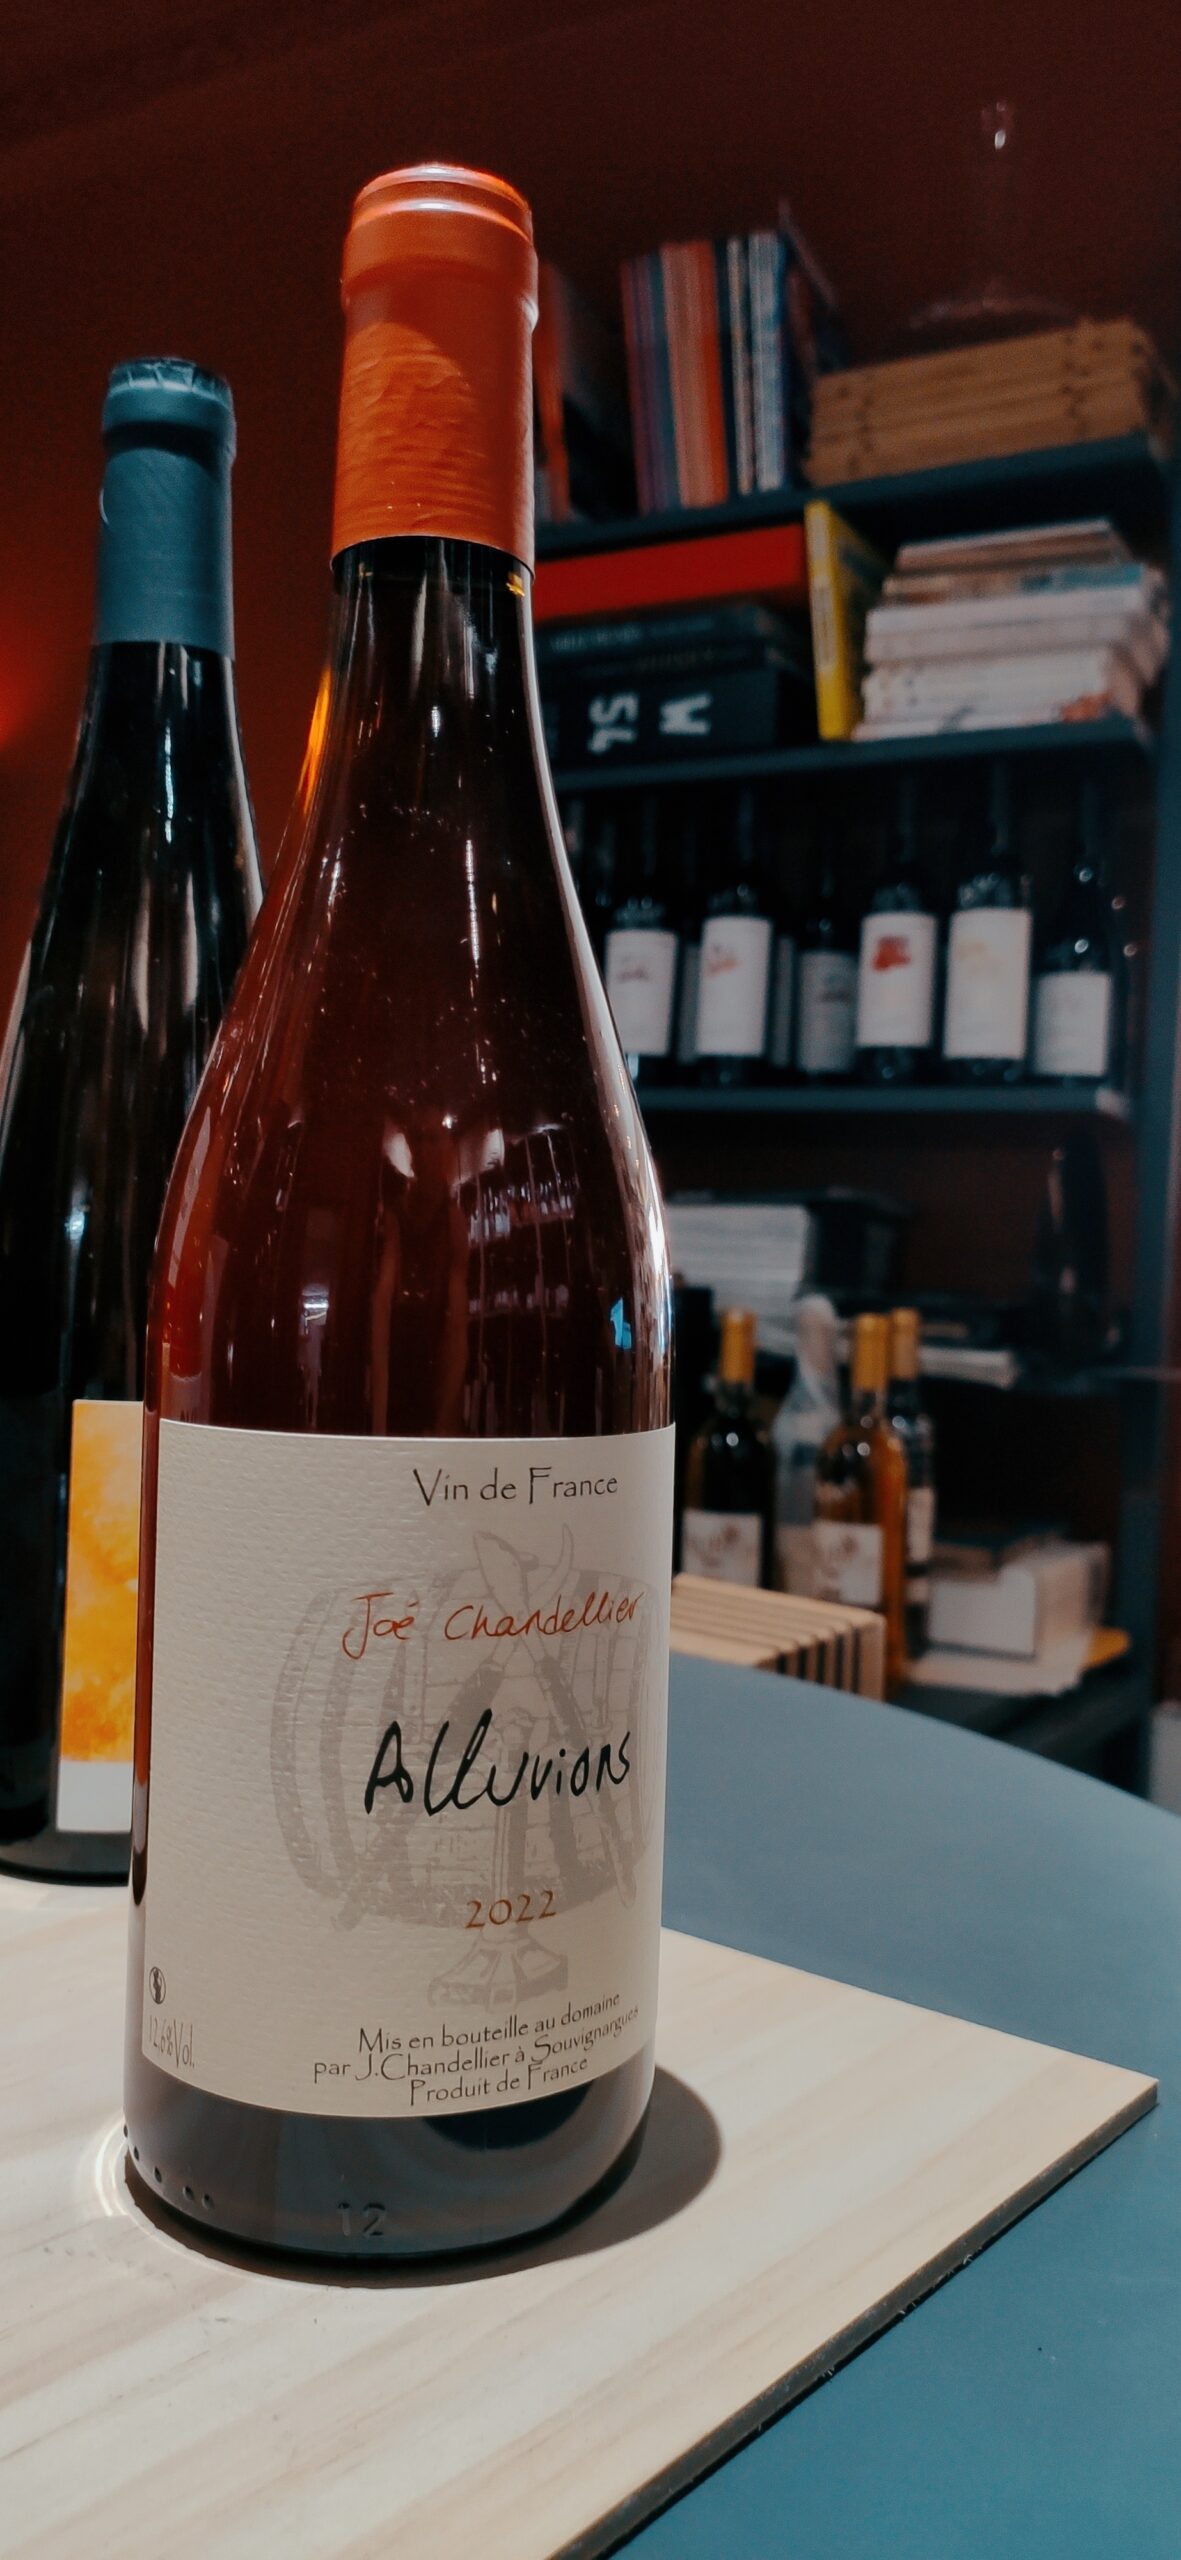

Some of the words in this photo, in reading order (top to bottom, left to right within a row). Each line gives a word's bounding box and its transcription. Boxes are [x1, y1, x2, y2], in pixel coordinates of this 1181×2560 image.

[413, 1468, 468, 1506] Vin
[480, 1467, 517, 1500] de
[529, 1466, 618, 1504] France
[342, 1591, 418, 1660] Joé
[444, 1592, 644, 1640] Chandellier
[364, 1708, 630, 1816] Alluvions
[465, 1889, 557, 1929] 2022
[314, 2061, 351, 2084] par
[514, 2046, 525, 2063] à
[530, 2005, 639, 2065] Souvignargues
[359, 2027, 401, 2053] Mis
[408, 2036, 434, 2049] en
[441, 2014, 529, 2047] bouteille
[534, 2017, 555, 2033] au
[560, 1993, 620, 2027] domaine
[410, 2075, 491, 2107] Produit
[496, 2069, 520, 2093] de
[527, 2058, 588, 2090] France
